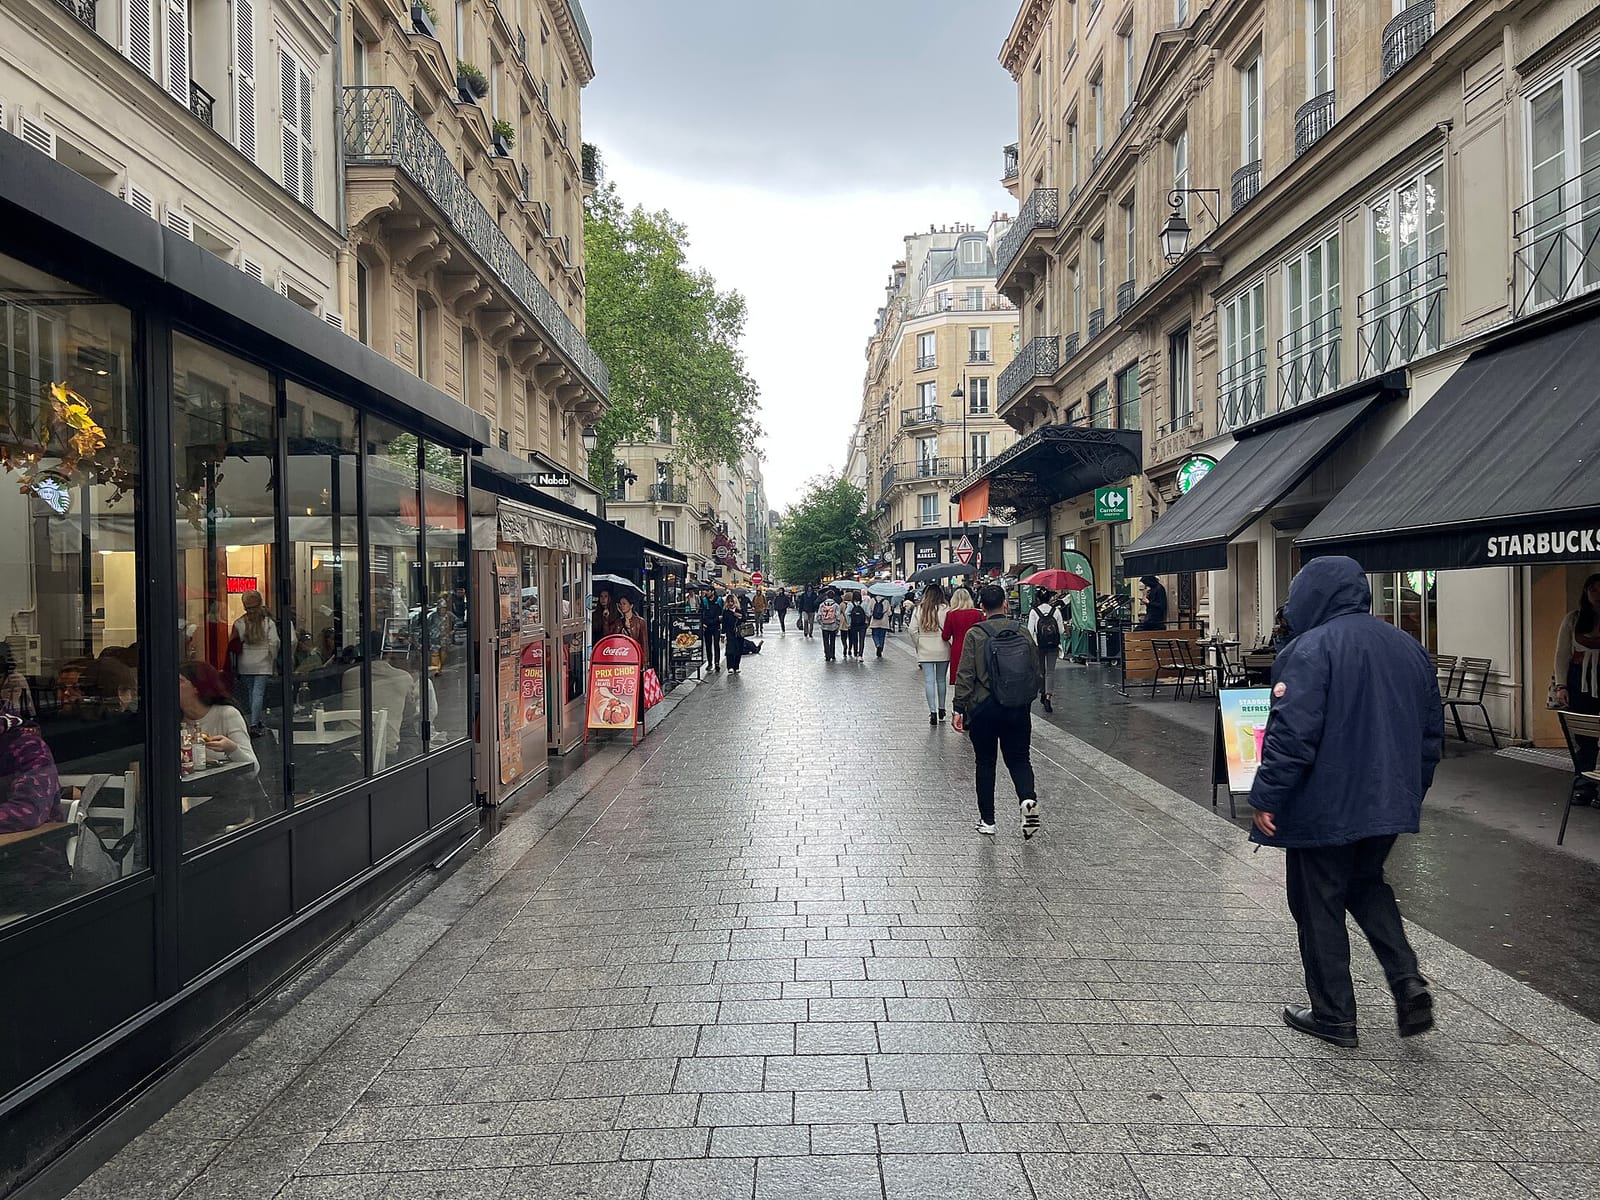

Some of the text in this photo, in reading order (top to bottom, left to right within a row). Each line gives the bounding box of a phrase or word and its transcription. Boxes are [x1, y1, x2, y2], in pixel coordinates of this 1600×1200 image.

[539, 474, 569, 485] Nabab
[595, 666, 635, 678] PRIX CHOC
[612, 677, 636, 696] 5€
